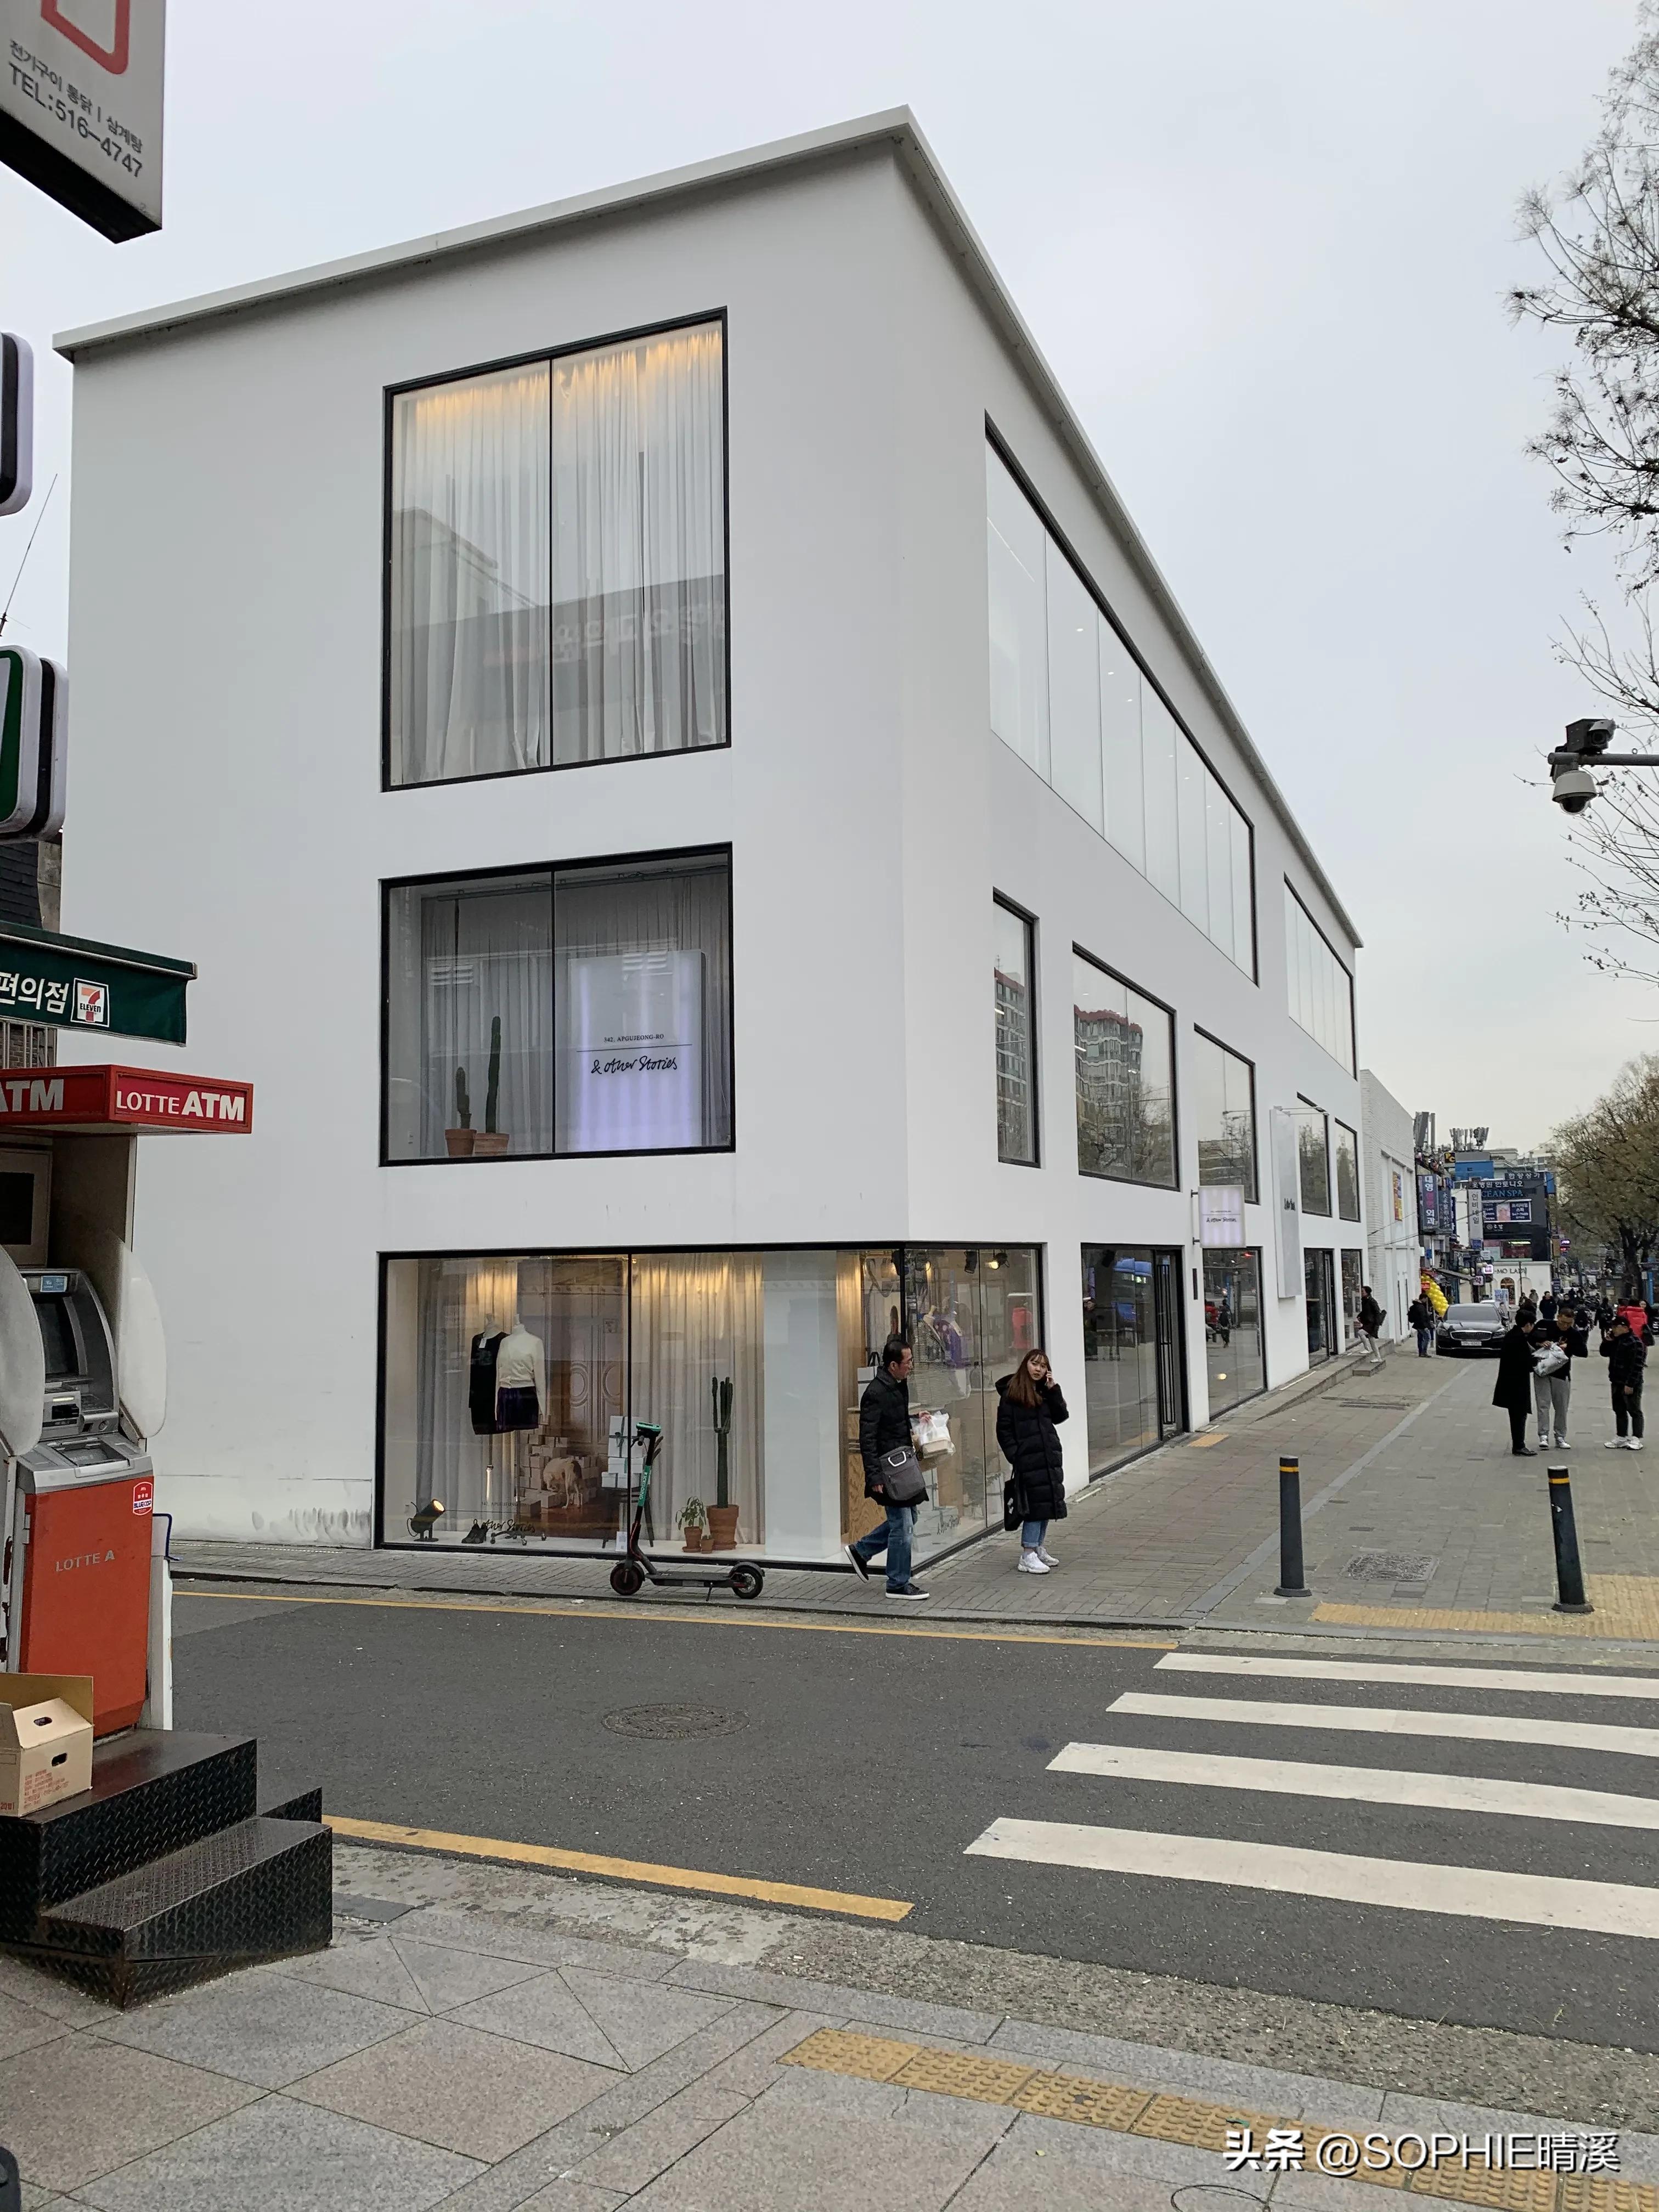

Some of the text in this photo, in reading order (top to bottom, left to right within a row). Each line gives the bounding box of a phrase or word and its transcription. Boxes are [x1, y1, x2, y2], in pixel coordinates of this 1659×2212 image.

[10, 39, 62, 92] 전기구이
[106, 116, 143, 154] 삼계탕
[9, 61, 143, 177] TEL:516-4747
[0, 972, 69, 1014] 편의점
[591, 1055, 678, 1074] & other Stories
[116, 1090, 245, 1121] LOTTE ATM
[1481, 1189, 1506, 1198] CEAN
[55, 1553, 101, 1572] LOTTE
